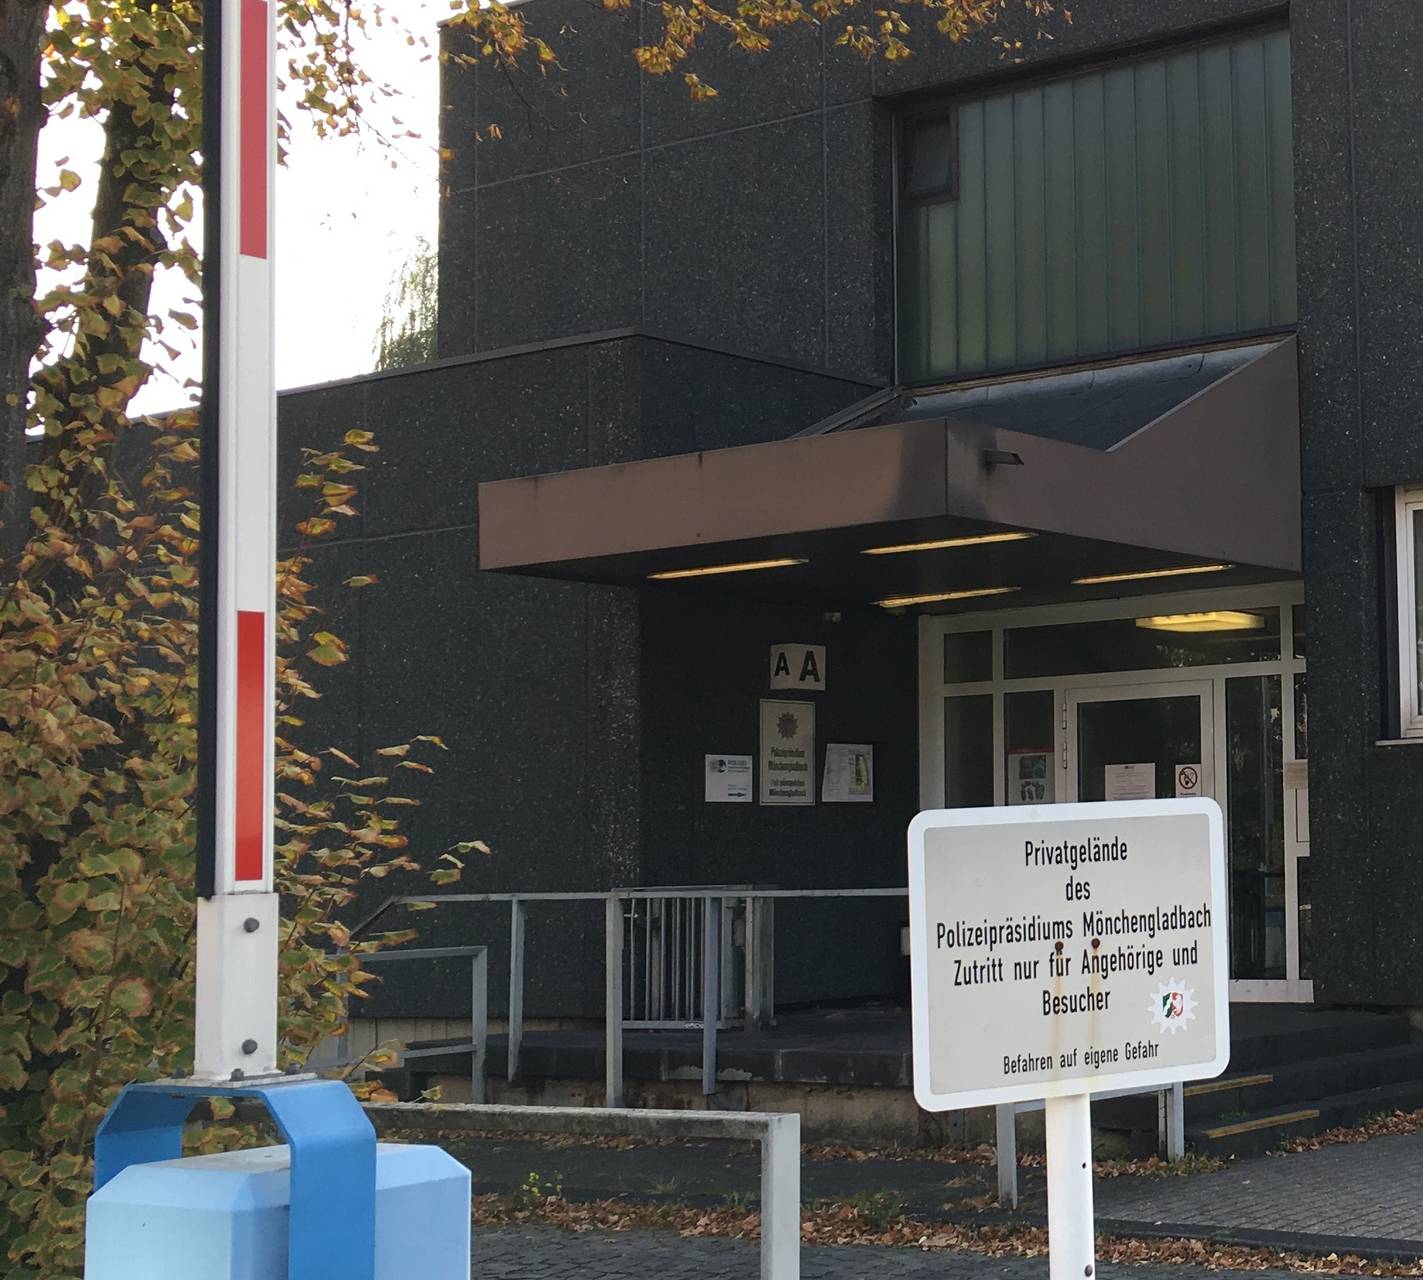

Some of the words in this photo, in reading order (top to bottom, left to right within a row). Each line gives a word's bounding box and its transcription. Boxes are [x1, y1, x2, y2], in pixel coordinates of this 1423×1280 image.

[774, 652, 790, 676] A
[799, 650, 821, 682] A
[1024, 836, 1128, 870] Privatgelände
[1065, 875, 1091, 901] des
[936, 915, 1073, 951] Polizeipräsidiums
[1083, 903, 1212, 940] Mönchengladbach
[954, 957, 1003, 986] Zutritt
[1014, 960, 1040, 981] nur
[1049, 950, 1071, 977] für
[1081, 945, 1164, 979] Angehörige
[1173, 940, 1198, 966] und
[1042, 986, 1111, 1016] Besucher
[1003, 1054, 1053, 1074] Befahren
[1060, 1048, 1077, 1068] auf
[1084, 1047, 1119, 1069] eigene
[1125, 1040, 1159, 1060] Gefahr
